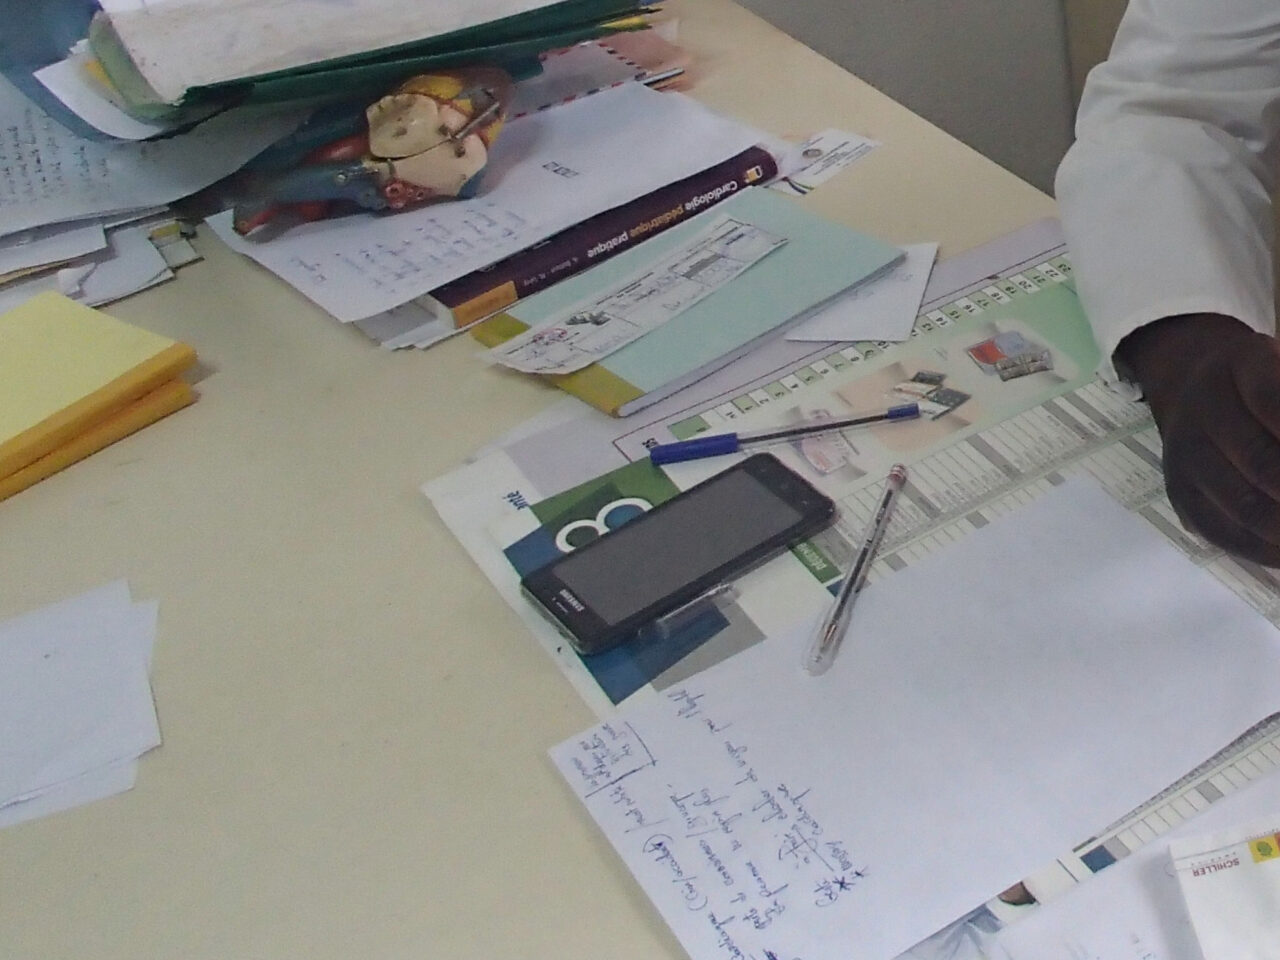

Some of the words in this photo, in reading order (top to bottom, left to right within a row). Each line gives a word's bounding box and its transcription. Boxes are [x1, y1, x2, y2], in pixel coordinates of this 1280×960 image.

[685, 180, 738, 212] Cardiologie
[630, 203, 684, 239] pédiatrique
[587, 231, 629, 259] pratique
[1191, 857, 1240, 877] SCHILLER
